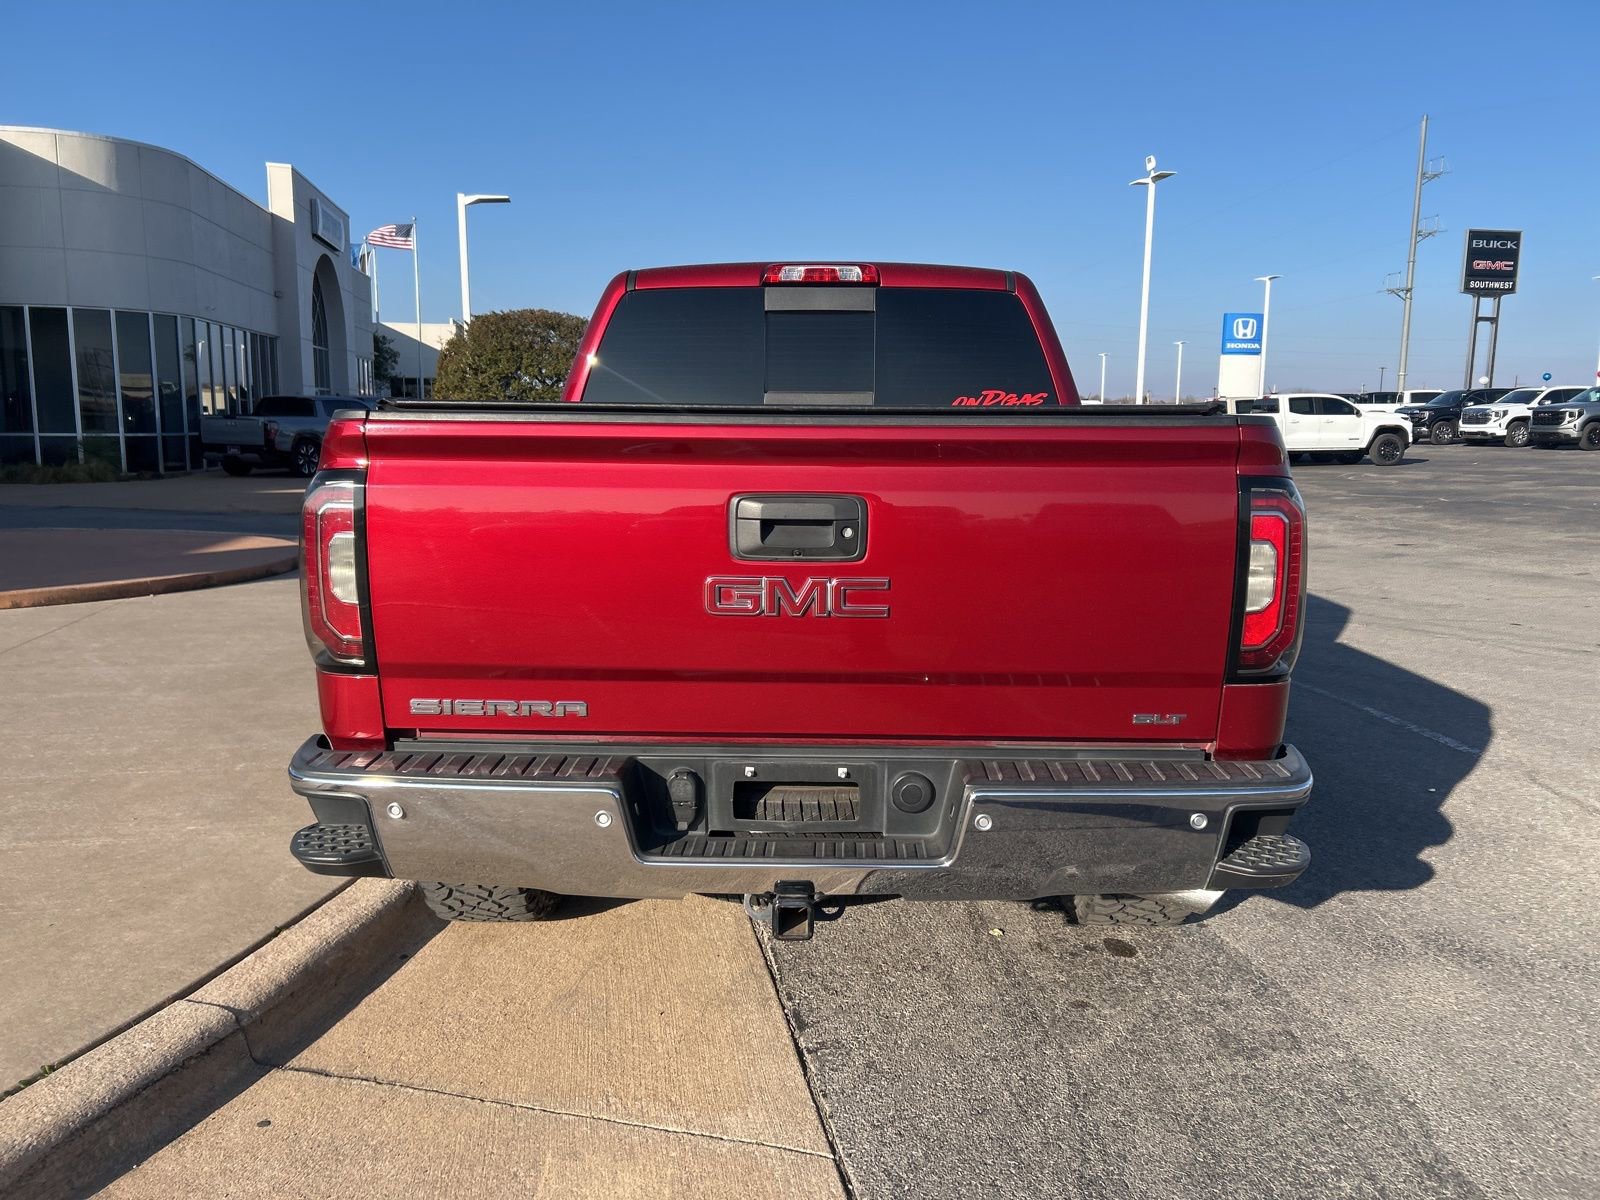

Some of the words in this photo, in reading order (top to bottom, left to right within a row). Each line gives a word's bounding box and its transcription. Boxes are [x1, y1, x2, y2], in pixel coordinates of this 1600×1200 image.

[1472, 239, 1518, 249] BUICK
[1472, 260, 1514, 271] GMC
[1469, 280, 1514, 289] SOUTHWEST
[704, 575, 891, 618] GMC
[409, 698, 590, 717] SIERRA
[1132, 713, 1188, 725] SLT
